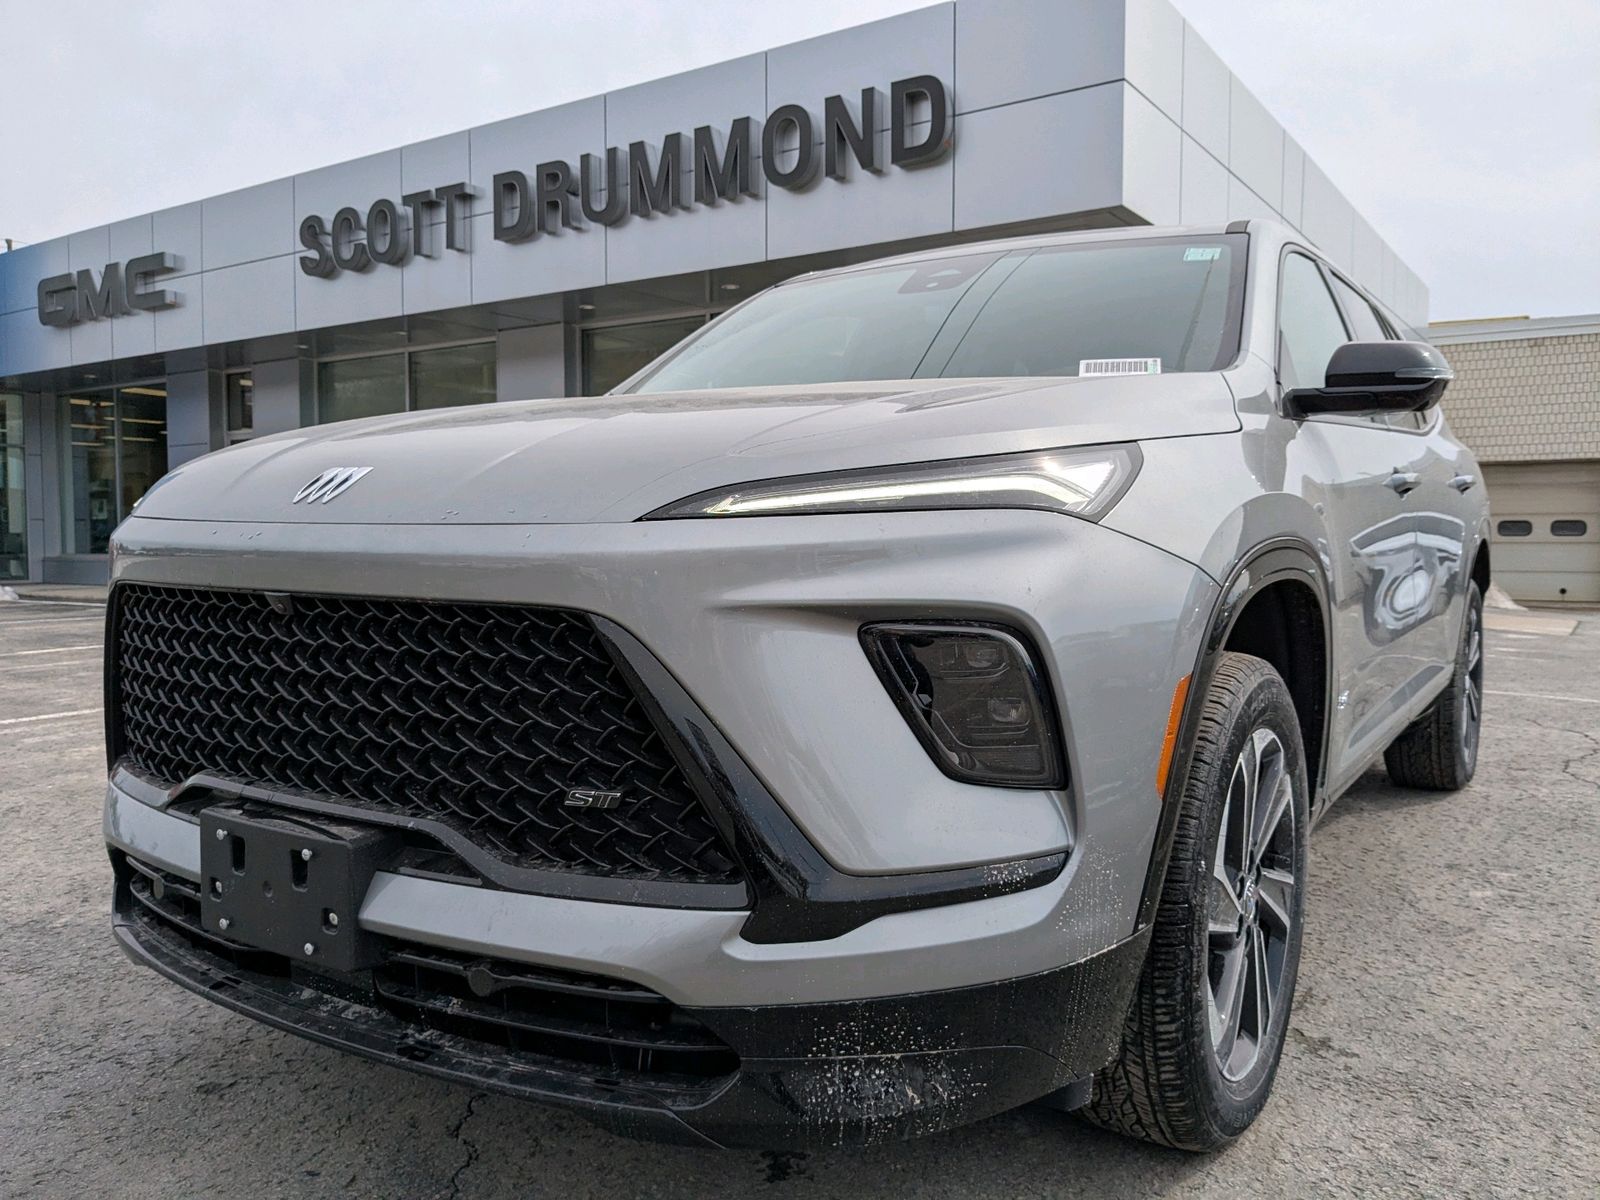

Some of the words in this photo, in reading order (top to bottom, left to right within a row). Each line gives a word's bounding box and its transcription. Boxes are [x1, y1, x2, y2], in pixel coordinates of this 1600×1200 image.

[299, 183, 474, 278] SCOTT
[493, 74, 952, 243] DRUMMOND
[38, 252, 177, 327] GMC
[564, 790, 621, 808] ST
